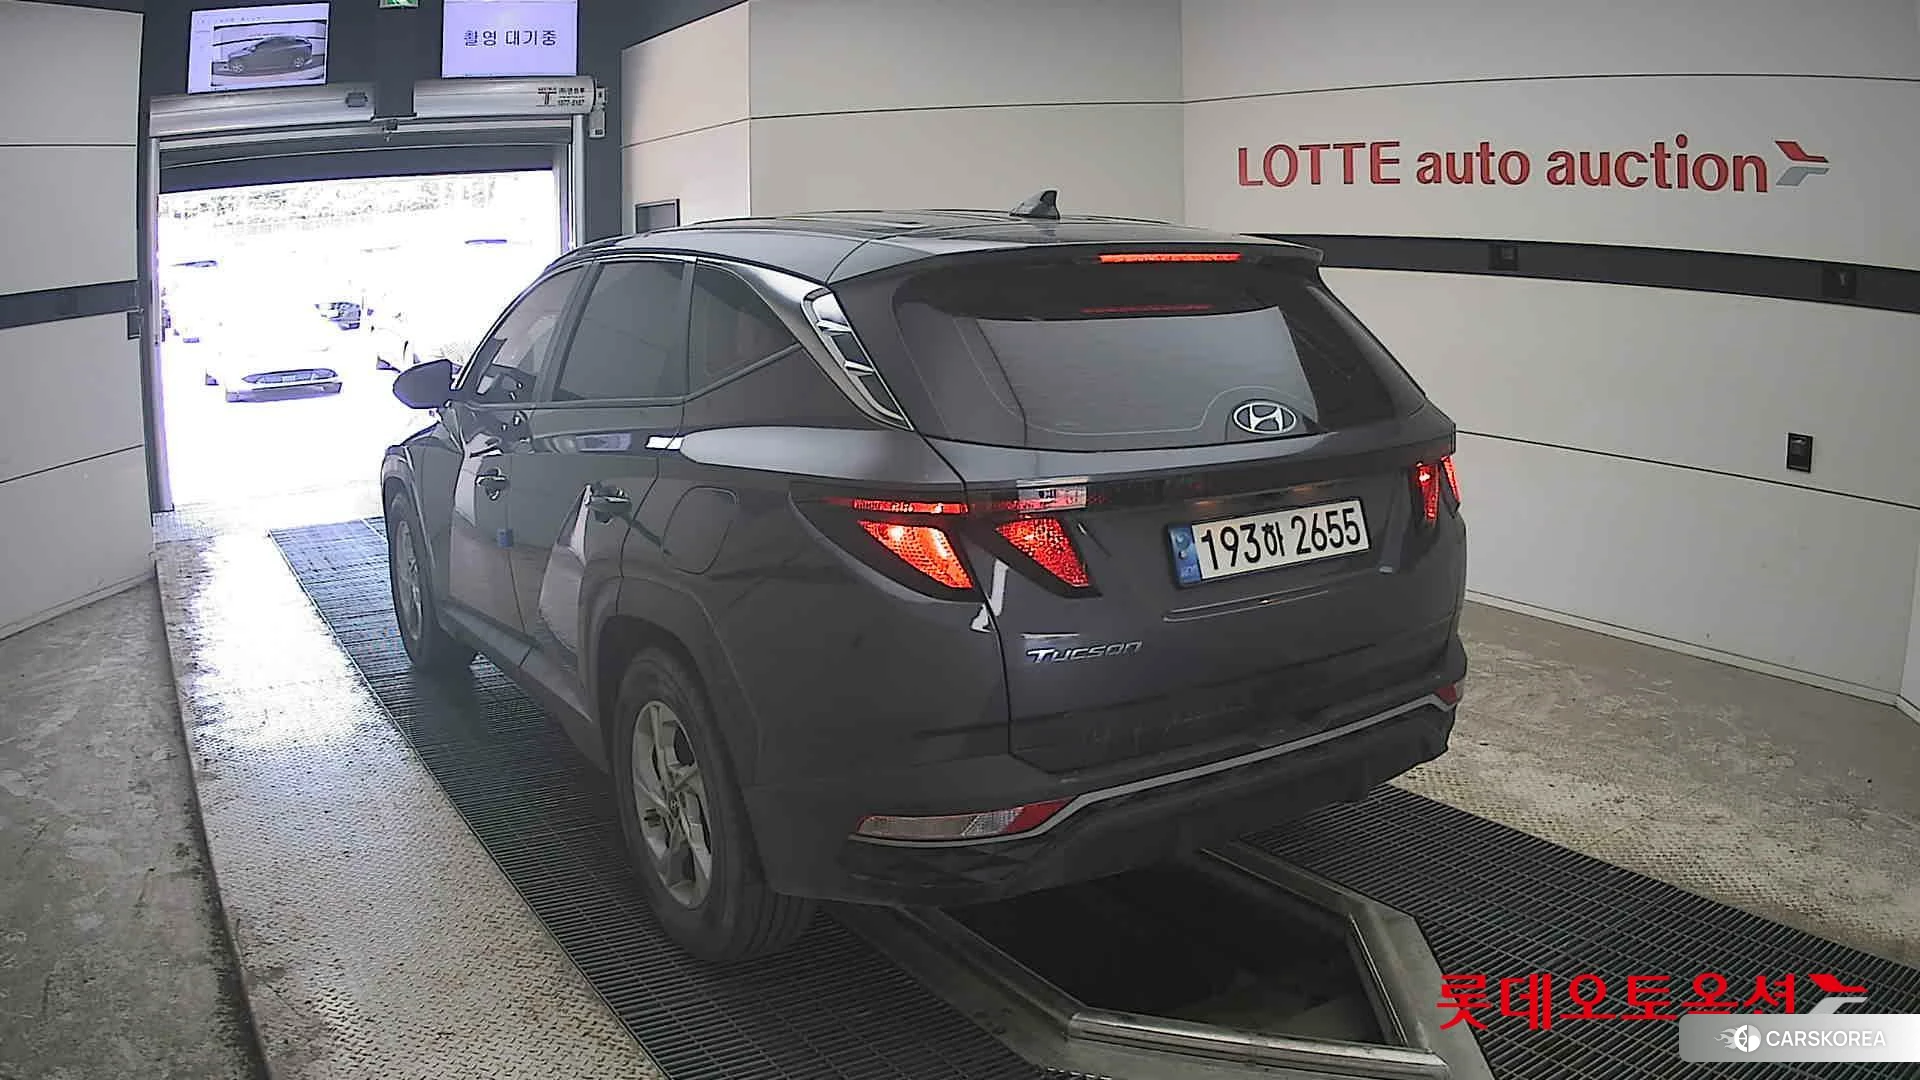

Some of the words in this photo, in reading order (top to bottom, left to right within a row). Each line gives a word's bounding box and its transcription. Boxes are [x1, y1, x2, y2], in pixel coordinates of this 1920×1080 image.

[505, 30, 557, 46] 대기중
[1238, 141, 1400, 187] LOTTE
[1416, 141, 1530, 186] auto
[1546, 133, 1769, 193] auction
[1201, 521, 1285, 570] 193하
[1291, 507, 1361, 555] 2655
